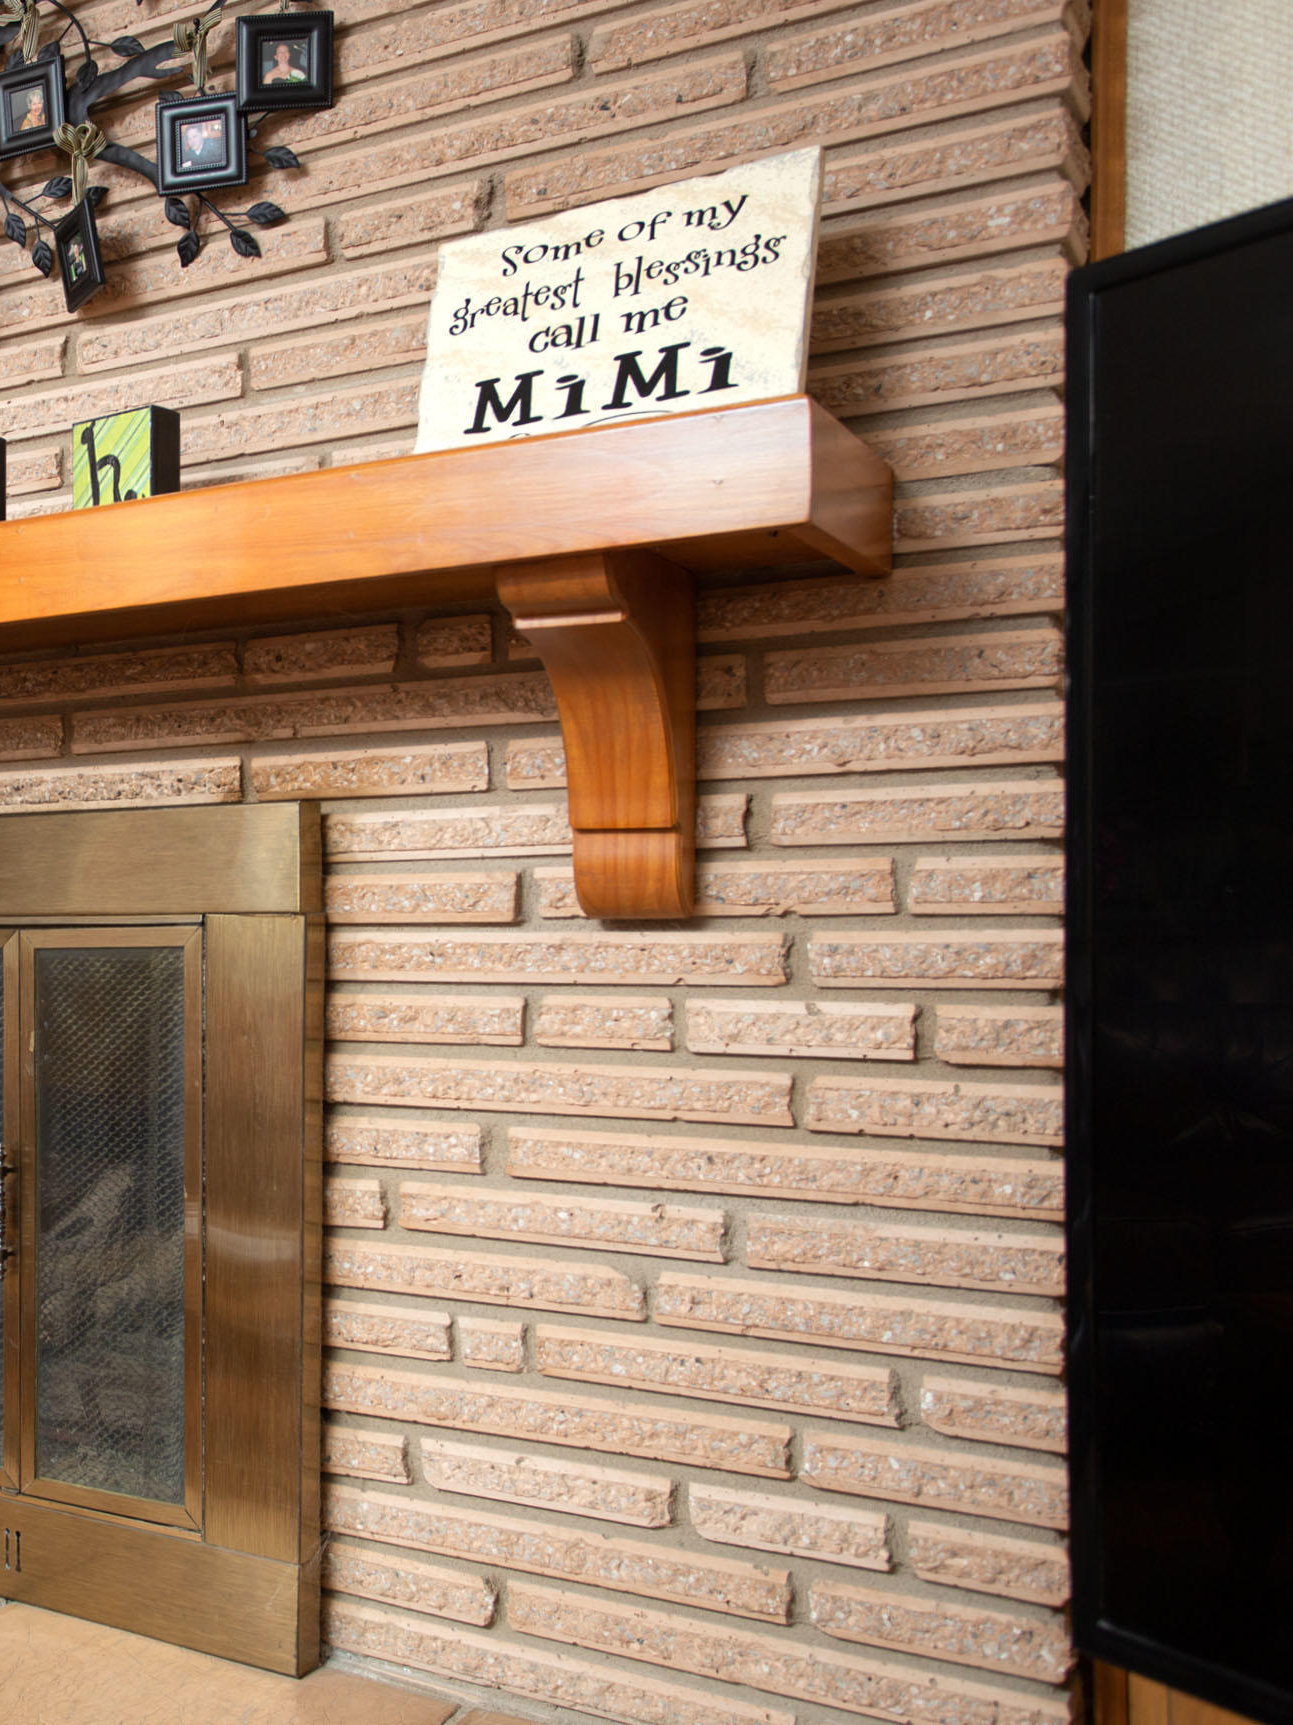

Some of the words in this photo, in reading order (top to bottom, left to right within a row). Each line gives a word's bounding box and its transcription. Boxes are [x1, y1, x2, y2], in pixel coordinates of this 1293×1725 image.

[502, 228, 605, 277] Some
[617, 211, 673, 242] of
[682, 194, 749, 231] my
[449, 266, 585, 336] greatest
[613, 234, 787, 298] blessings
[528, 313, 600, 353] call
[620, 295, 689, 335] me
[463, 341, 740, 435] MiMi
